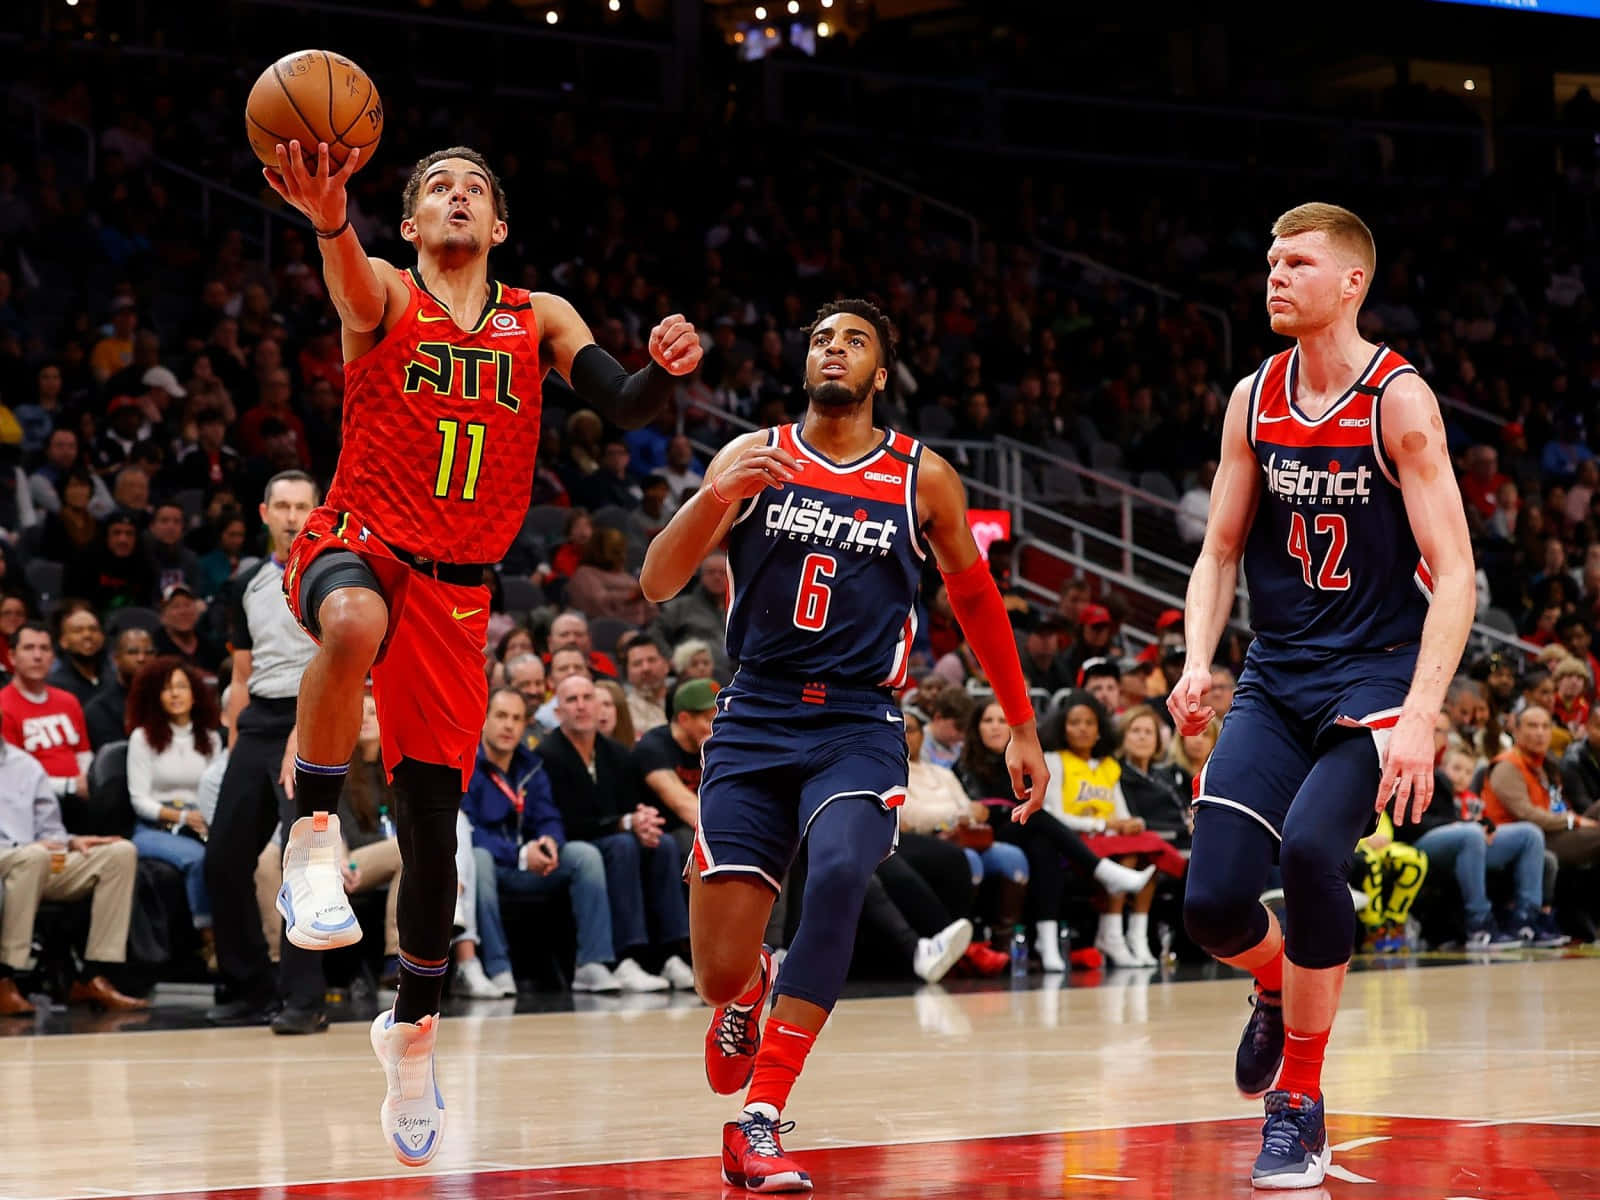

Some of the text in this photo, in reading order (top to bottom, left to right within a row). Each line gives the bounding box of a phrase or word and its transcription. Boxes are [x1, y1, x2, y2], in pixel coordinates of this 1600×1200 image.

[404, 341, 521, 414] ATL
[1338, 417, 1370, 427] GEICO
[434, 418, 486, 501] 11
[863, 470, 902, 485] GEICO
[1281, 459, 1301, 470] THE
[765, 490, 898, 550] district
[801, 497, 824, 510] THE
[788, 532, 888, 557] COLUMBIA
[1287, 511, 1351, 591] 42
[793, 552, 837, 633] 6
[22, 712, 80, 752] ATL
